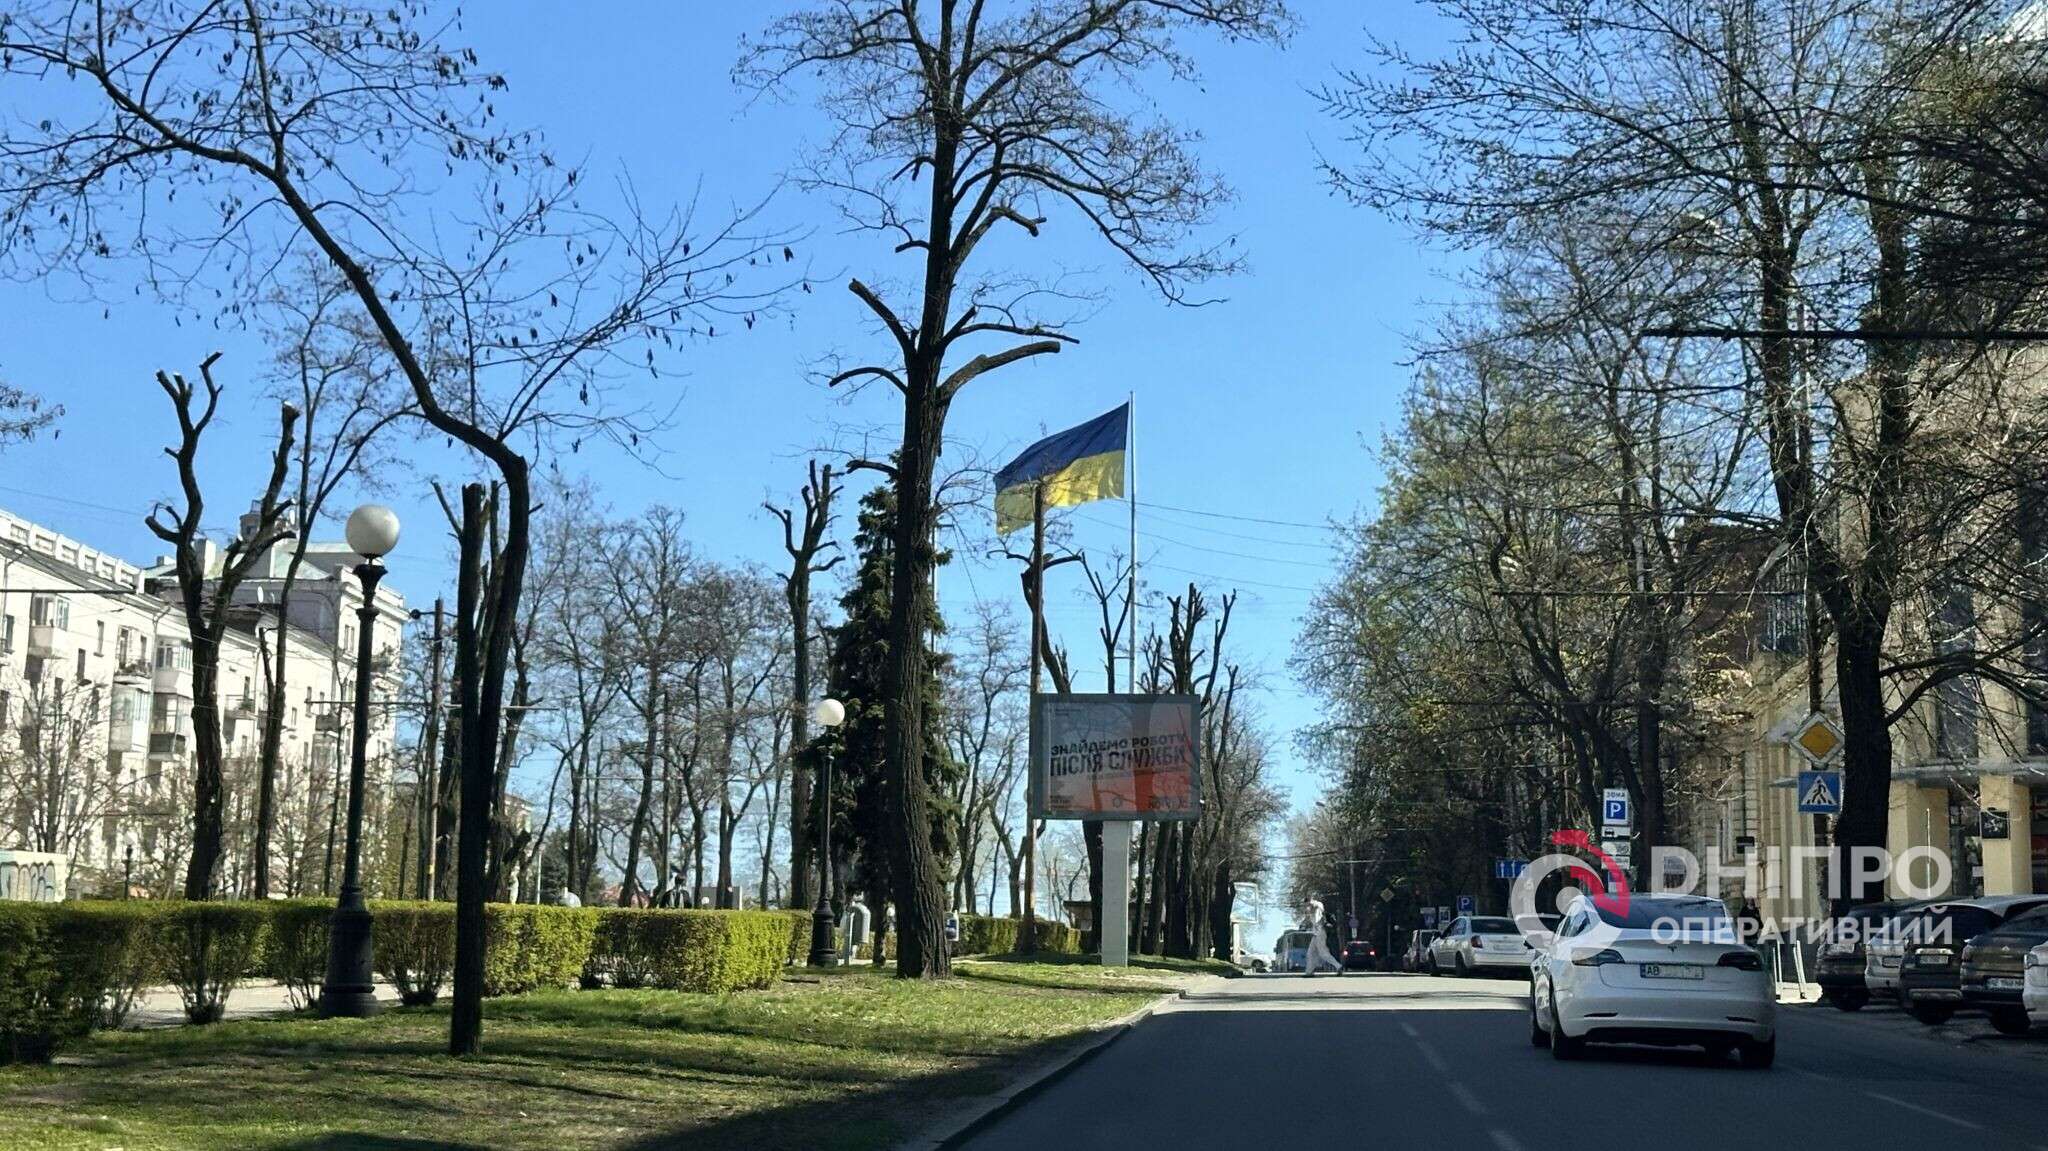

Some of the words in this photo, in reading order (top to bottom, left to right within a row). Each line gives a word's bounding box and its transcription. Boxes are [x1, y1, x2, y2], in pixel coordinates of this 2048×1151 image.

[1051, 740, 1129, 756] ЗНАЙДЕМО
[1050, 752, 1104, 776] ПІСЛЯ
[1610, 802, 1621, 817] P
